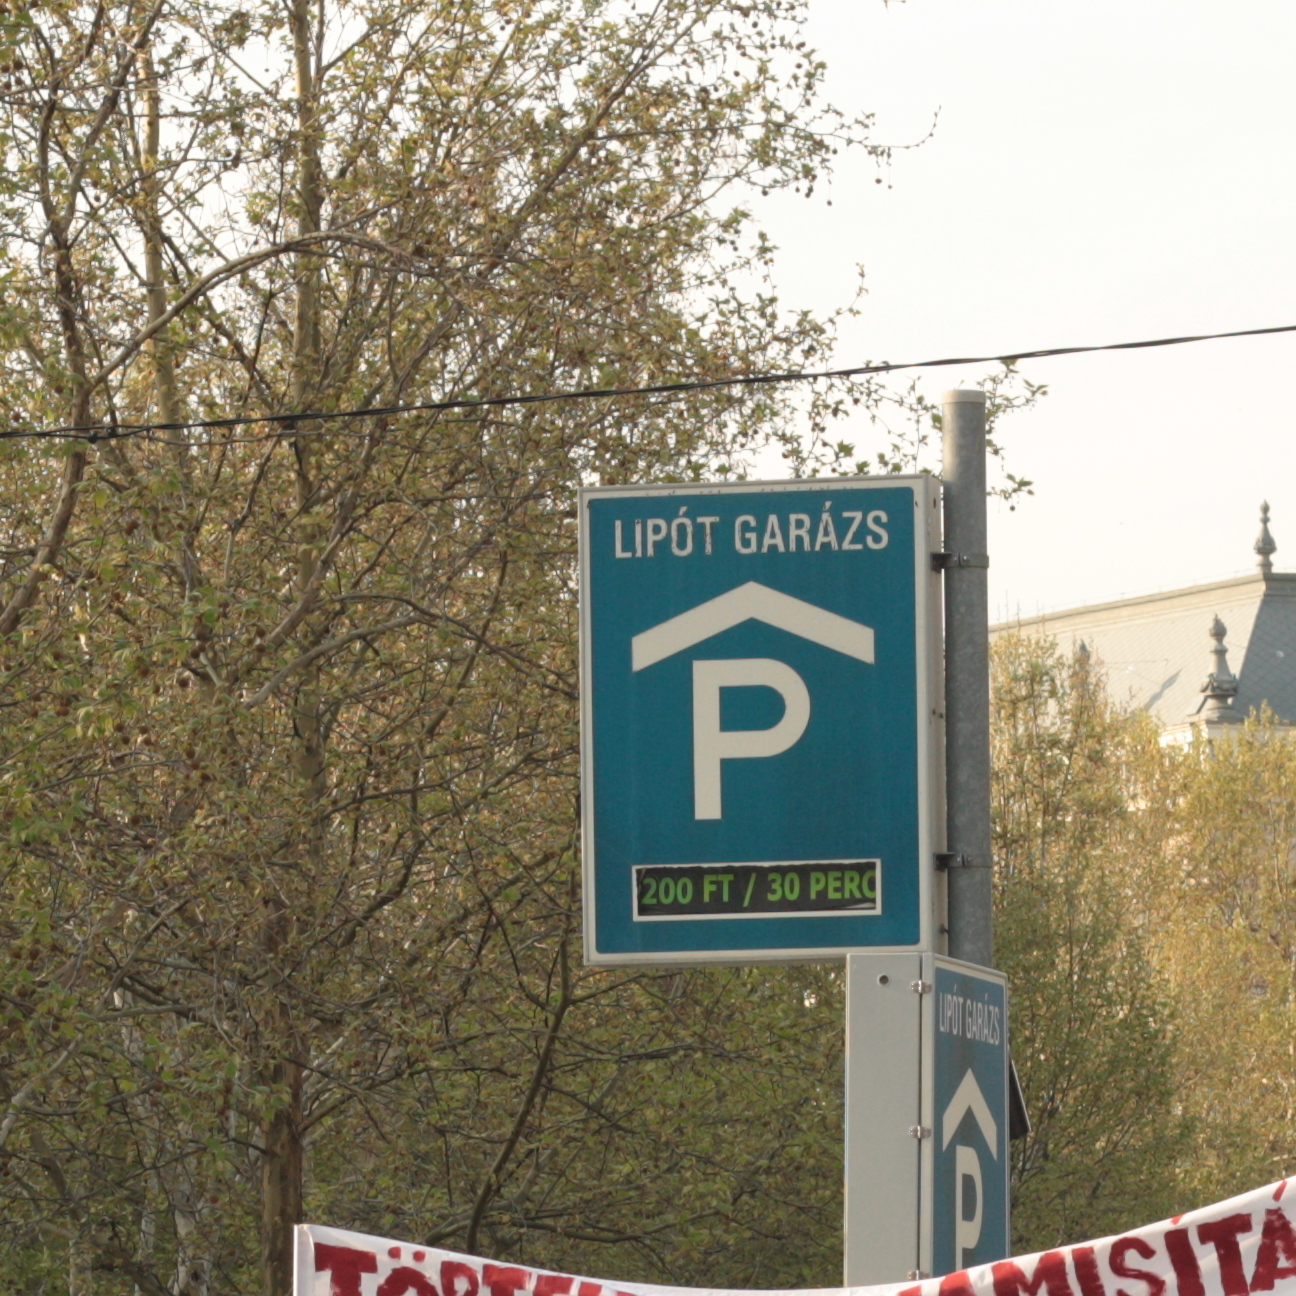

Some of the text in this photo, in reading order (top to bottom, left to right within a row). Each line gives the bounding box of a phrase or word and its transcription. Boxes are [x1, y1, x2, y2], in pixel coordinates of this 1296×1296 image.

[615, 501, 890, 559] LIPÓT GARÁZS
[692, 657, 811, 820] P
[641, 876, 693, 905] 200
[703, 873, 735, 903] FT
[767, 871, 800, 902] 30
[809, 869, 877, 901] PERC
[938, 987, 1001, 1046] LIPÓT GARÁZS
